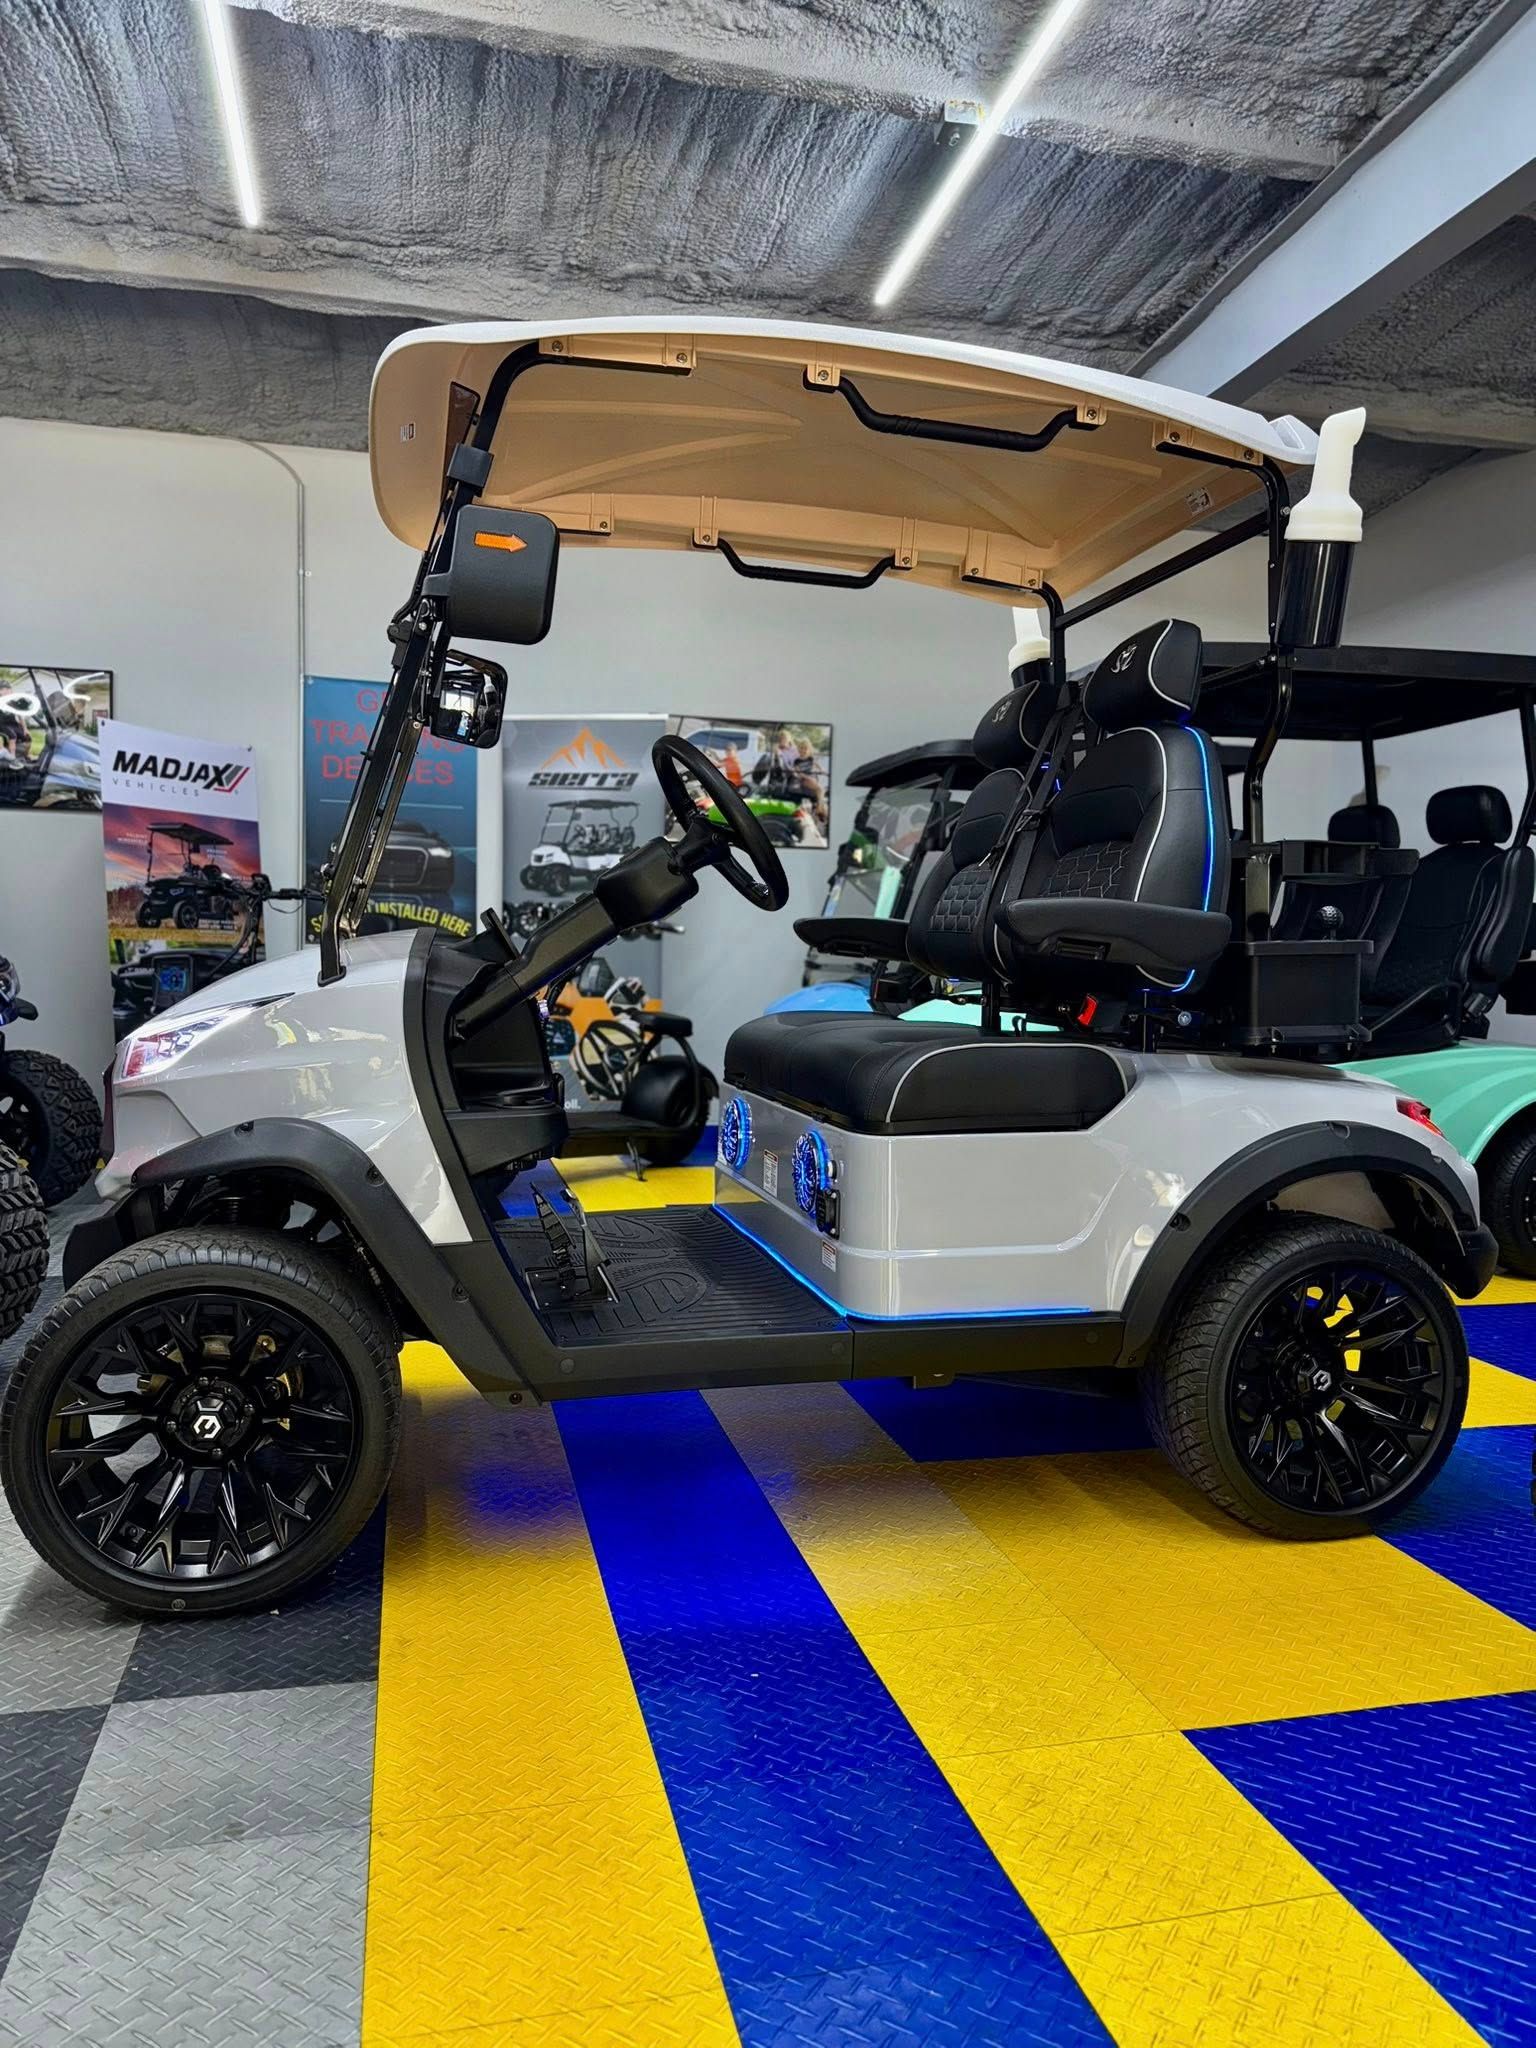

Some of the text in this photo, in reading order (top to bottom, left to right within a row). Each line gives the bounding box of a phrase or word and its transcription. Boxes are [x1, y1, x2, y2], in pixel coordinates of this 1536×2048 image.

[113, 750, 234, 790] MADJAX
[113, 778, 199, 796] VEHICLES
[375, 901, 439, 924] INSTALLED
[440, 912, 473, 937] HERE
